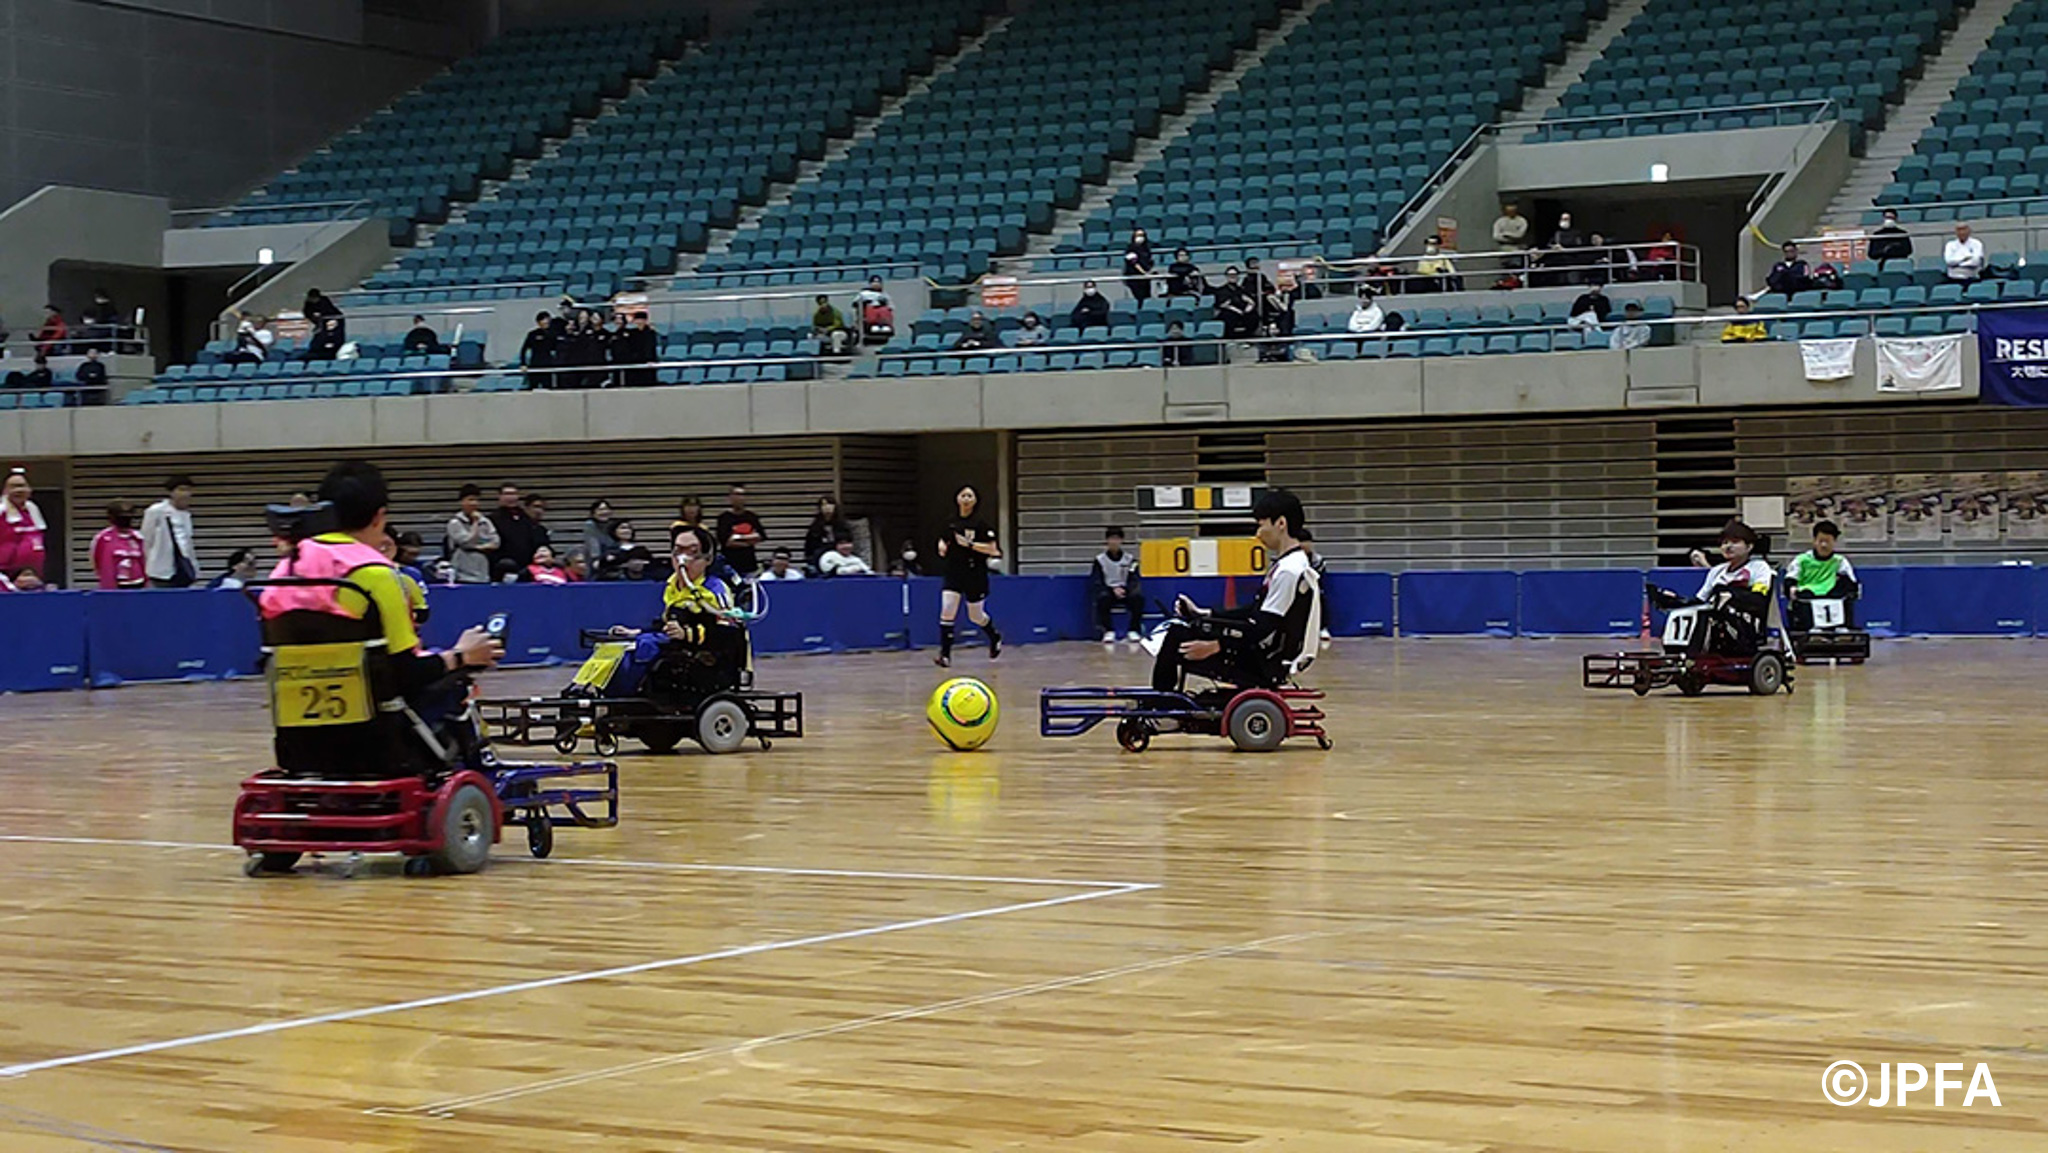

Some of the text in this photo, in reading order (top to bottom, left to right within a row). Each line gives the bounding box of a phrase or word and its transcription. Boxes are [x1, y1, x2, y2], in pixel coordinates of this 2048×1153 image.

[1174, 546, 1265, 573] 0 0
[1823, 604, 1832, 624] 1
[1672, 615, 1692, 641] 17
[301, 685, 347, 719] 25
